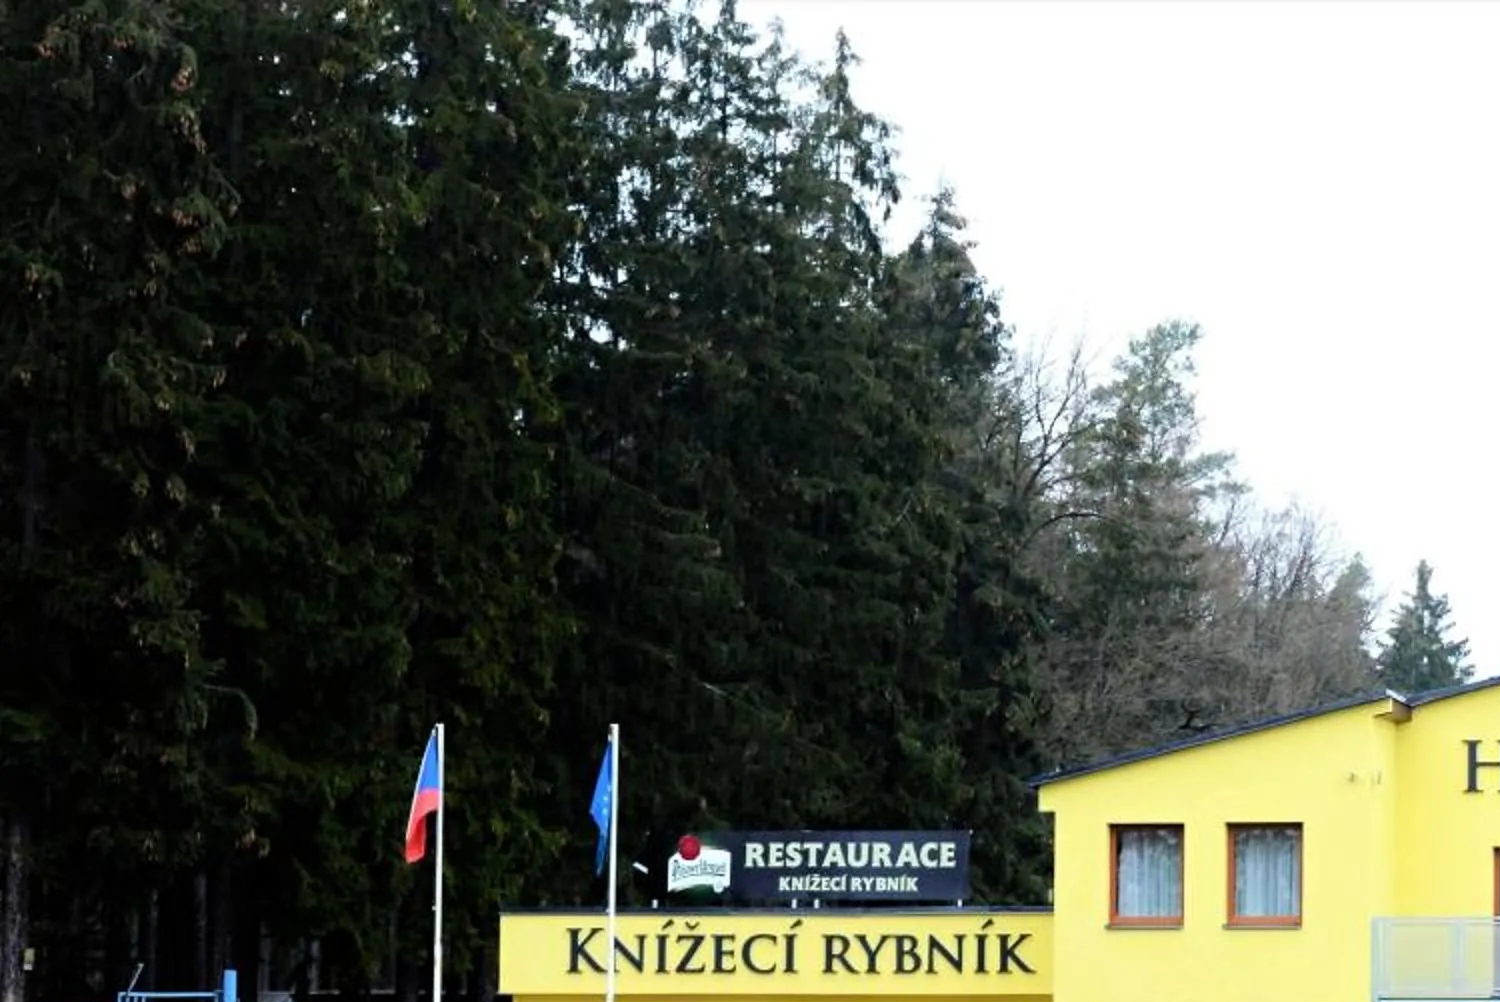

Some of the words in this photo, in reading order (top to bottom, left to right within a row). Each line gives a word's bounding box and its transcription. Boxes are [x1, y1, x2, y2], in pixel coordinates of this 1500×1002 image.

[744, 842, 957, 869] RESTAURACE
[778, 873, 848, 892] KNÍŽECÍ
[850, 873, 919, 893] RYBNÍK
[566, 918, 804, 975] KNÍŽECÍ
[822, 918, 1037, 975] RYBNÍK
